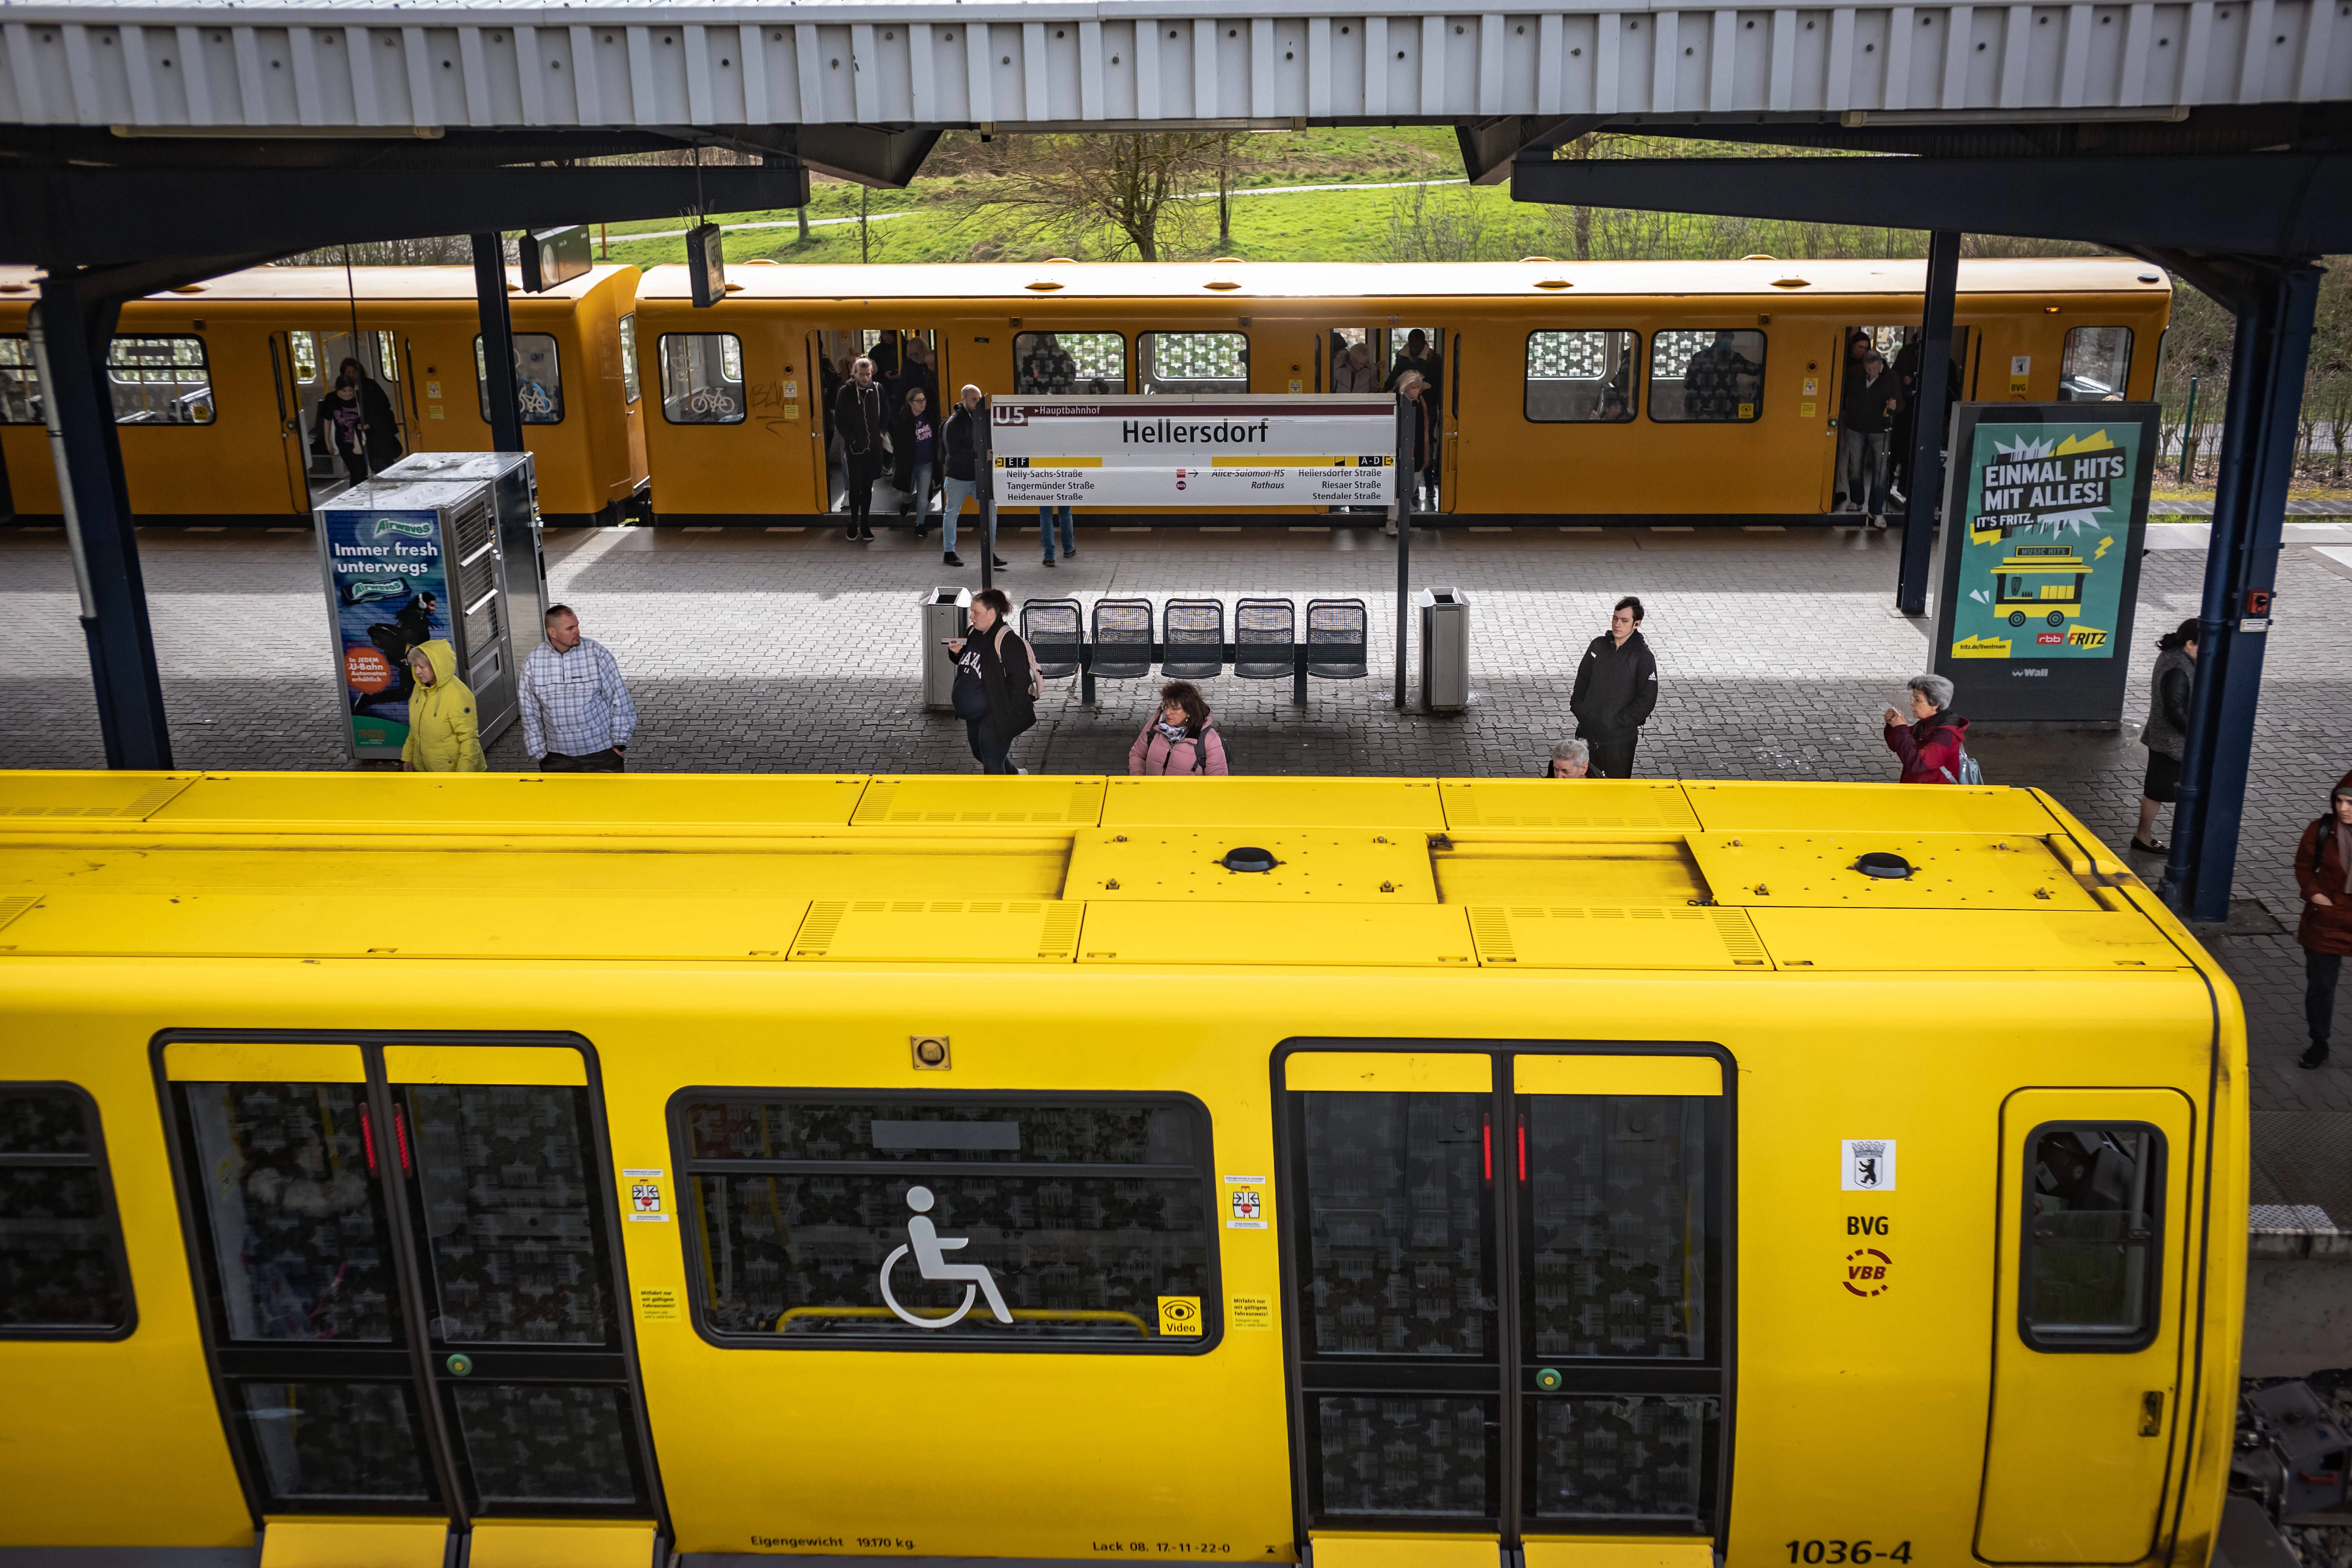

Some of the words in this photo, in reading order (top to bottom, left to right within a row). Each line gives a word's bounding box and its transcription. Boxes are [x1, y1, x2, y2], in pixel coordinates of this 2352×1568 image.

[996, 407, 1024, 424] U5
[1040, 406, 1100, 416] Hauptbahnhof
[1123, 418, 1269, 443] Hellersdorf
[1007, 470, 1083, 479] Nelly-Sachs-Straße
[1986, 461, 2067, 486] EINMAL
[2074, 456, 2124, 480] HITS
[1007, 482, 1065, 491] Tangermünder
[1985, 488, 2024, 511] MIT
[2029, 481, 2103, 507] ALLES!
[374, 518, 431, 537] Airwaves
[1976, 516, 1997, 528] IT'S
[2000, 513, 2033, 526] FRITZ.
[335, 543, 389, 556] Immer
[395, 542, 438, 556] fresh
[338, 561, 428, 576] unterwegs
[353, 583, 401, 599] Airwaves
[2039, 634, 2061, 642] rbb
[2067, 633, 2107, 644] FRITZ
[1847, 1216, 1889, 1235] BVG
[1848, 1266, 1886, 1279] VBB
[1167, 1323, 1195, 1332] Video
[751, 1536, 844, 1548] Eigengewicht
[1093, 1542, 1123, 1551] Lack
[1130, 1543, 1149, 1551] 08.
[1786, 1540, 1913, 1564] 1036-4
